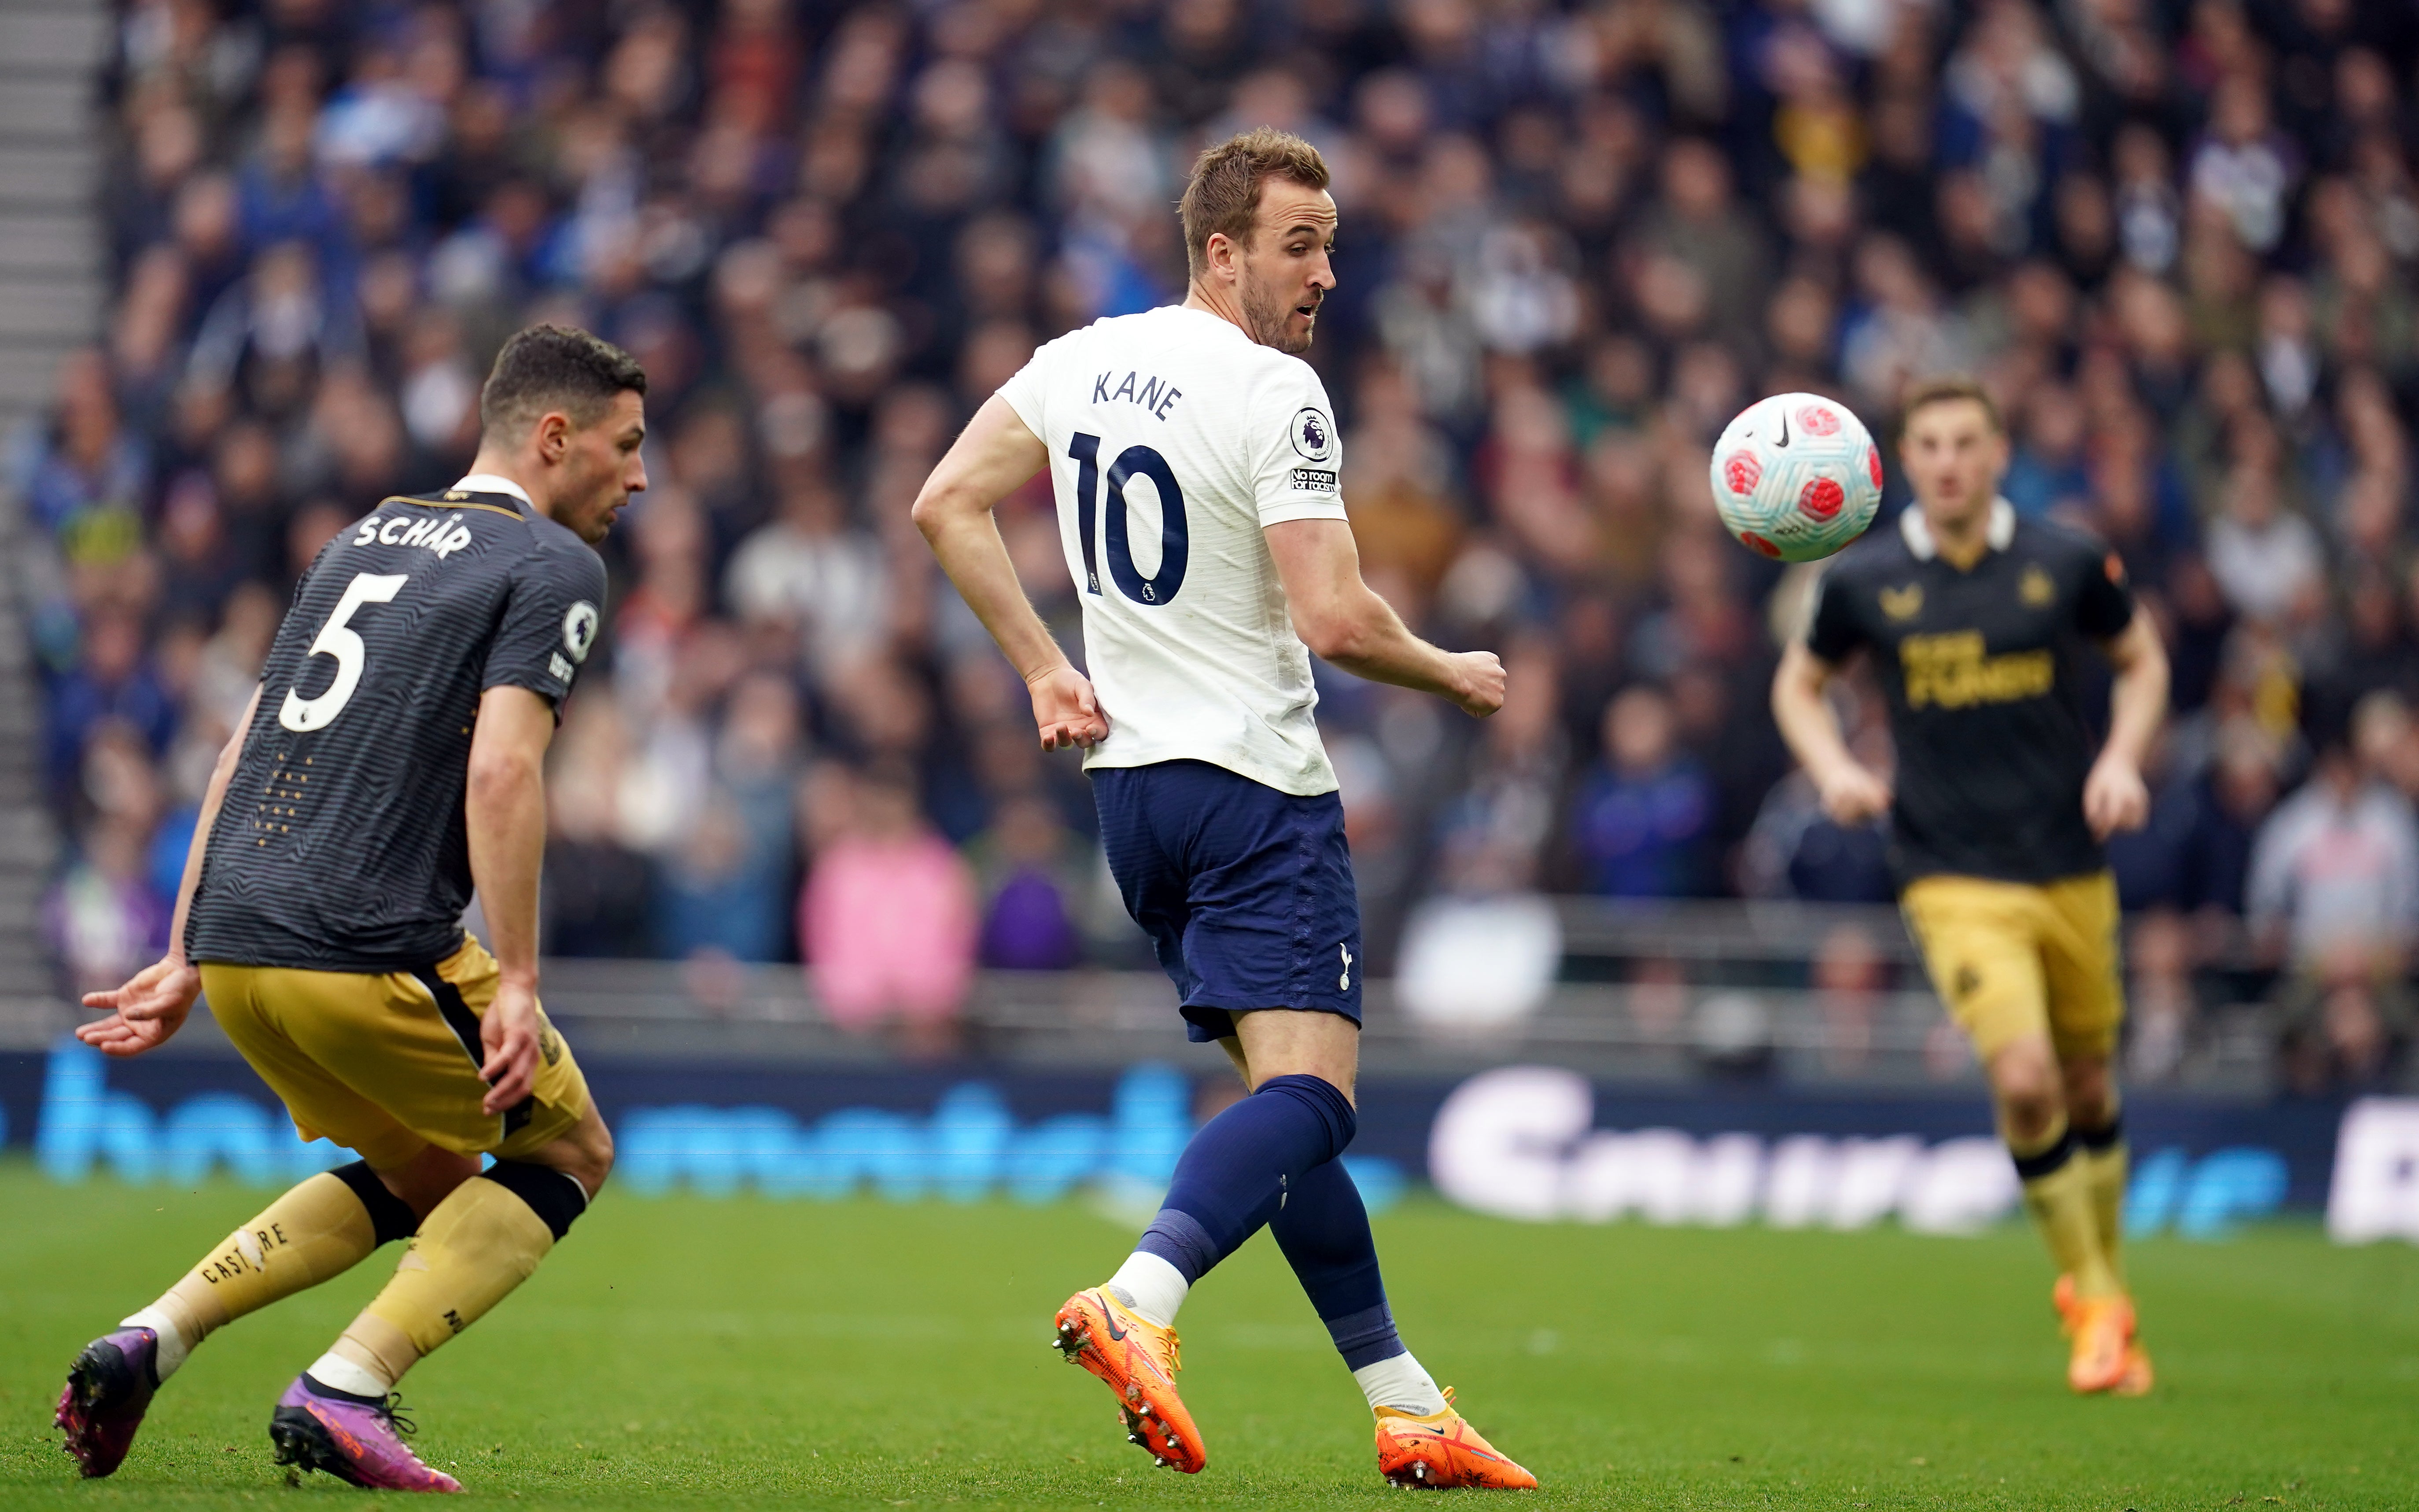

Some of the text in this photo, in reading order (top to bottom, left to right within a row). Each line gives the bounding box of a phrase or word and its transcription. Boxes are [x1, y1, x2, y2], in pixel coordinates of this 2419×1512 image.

[1092, 370, 1183, 423] KANE
[1291, 469, 1333, 483] No room
[1291, 478, 1308, 490] for
[353, 512, 472, 560] SCHÄR
[1068, 431, 1189, 606] 10
[278, 572, 410, 732] 5
[202, 1222, 288, 1284] CASTRE
[305, 1400, 365, 1460] ULTRA
